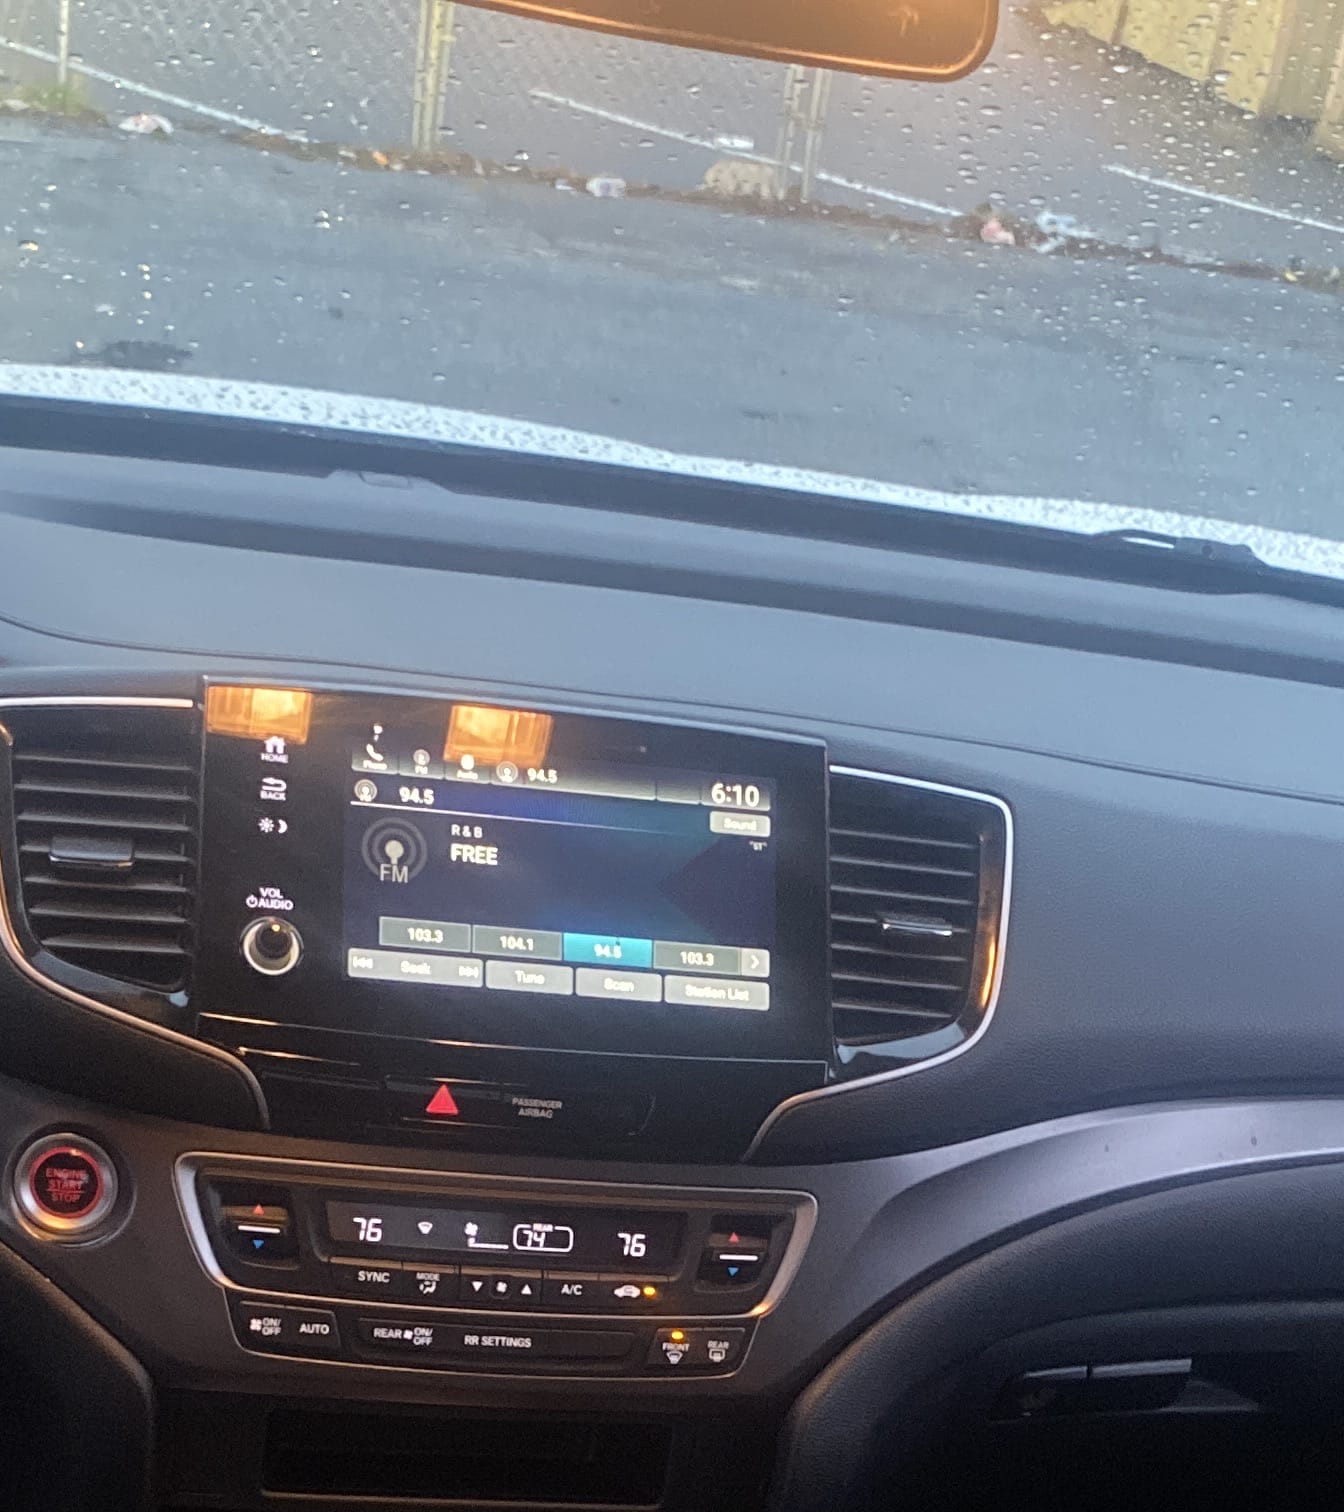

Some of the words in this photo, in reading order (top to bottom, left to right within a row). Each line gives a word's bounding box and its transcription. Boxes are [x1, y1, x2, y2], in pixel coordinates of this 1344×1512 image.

[261, 752, 289, 763] HOME
[527, 767, 557, 784] 94.5
[711, 783, 760, 807] 6:10
[260, 790, 286, 801] BACK
[399, 787, 435, 805] 94.5
[724, 818, 756, 832] Sound
[450, 843, 498, 866] FREE
[380, 864, 408, 883] FM
[260, 887, 283, 899] VOL
[258, 898, 294, 911] AUDIO
[408, 927, 443, 943] 103.3
[500, 935, 533, 951] 104.1
[680, 951, 714, 966] 103.3
[515, 970, 546, 985] Tune
[604, 978, 634, 992] Scan
[512, 1097, 563, 1110] PASSENGER
[518, 1107, 554, 1119] AIRBAG
[353, 1217, 383, 1242] 76
[522, 1230, 546, 1248] 74
[618, 1233, 646, 1257] 76
[358, 1270, 390, 1283] SYNC
[416, 1272, 440, 1282] MODE
[561, 1284, 583, 1295] A/C
[262, 1317, 281, 1327] ON/
[262, 1326, 281, 1336] OFF
[299, 1323, 330, 1335] AUTO
[373, 1328, 402, 1339] REAR
[414, 1327, 433, 1337] ON/
[413, 1336, 433, 1346] OFF
[464, 1335, 479, 1346] RR
[481, 1335, 531, 1348] SETTINGS
[662, 1342, 689, 1352] FRONT
[708, 1340, 729, 1350] REAR
